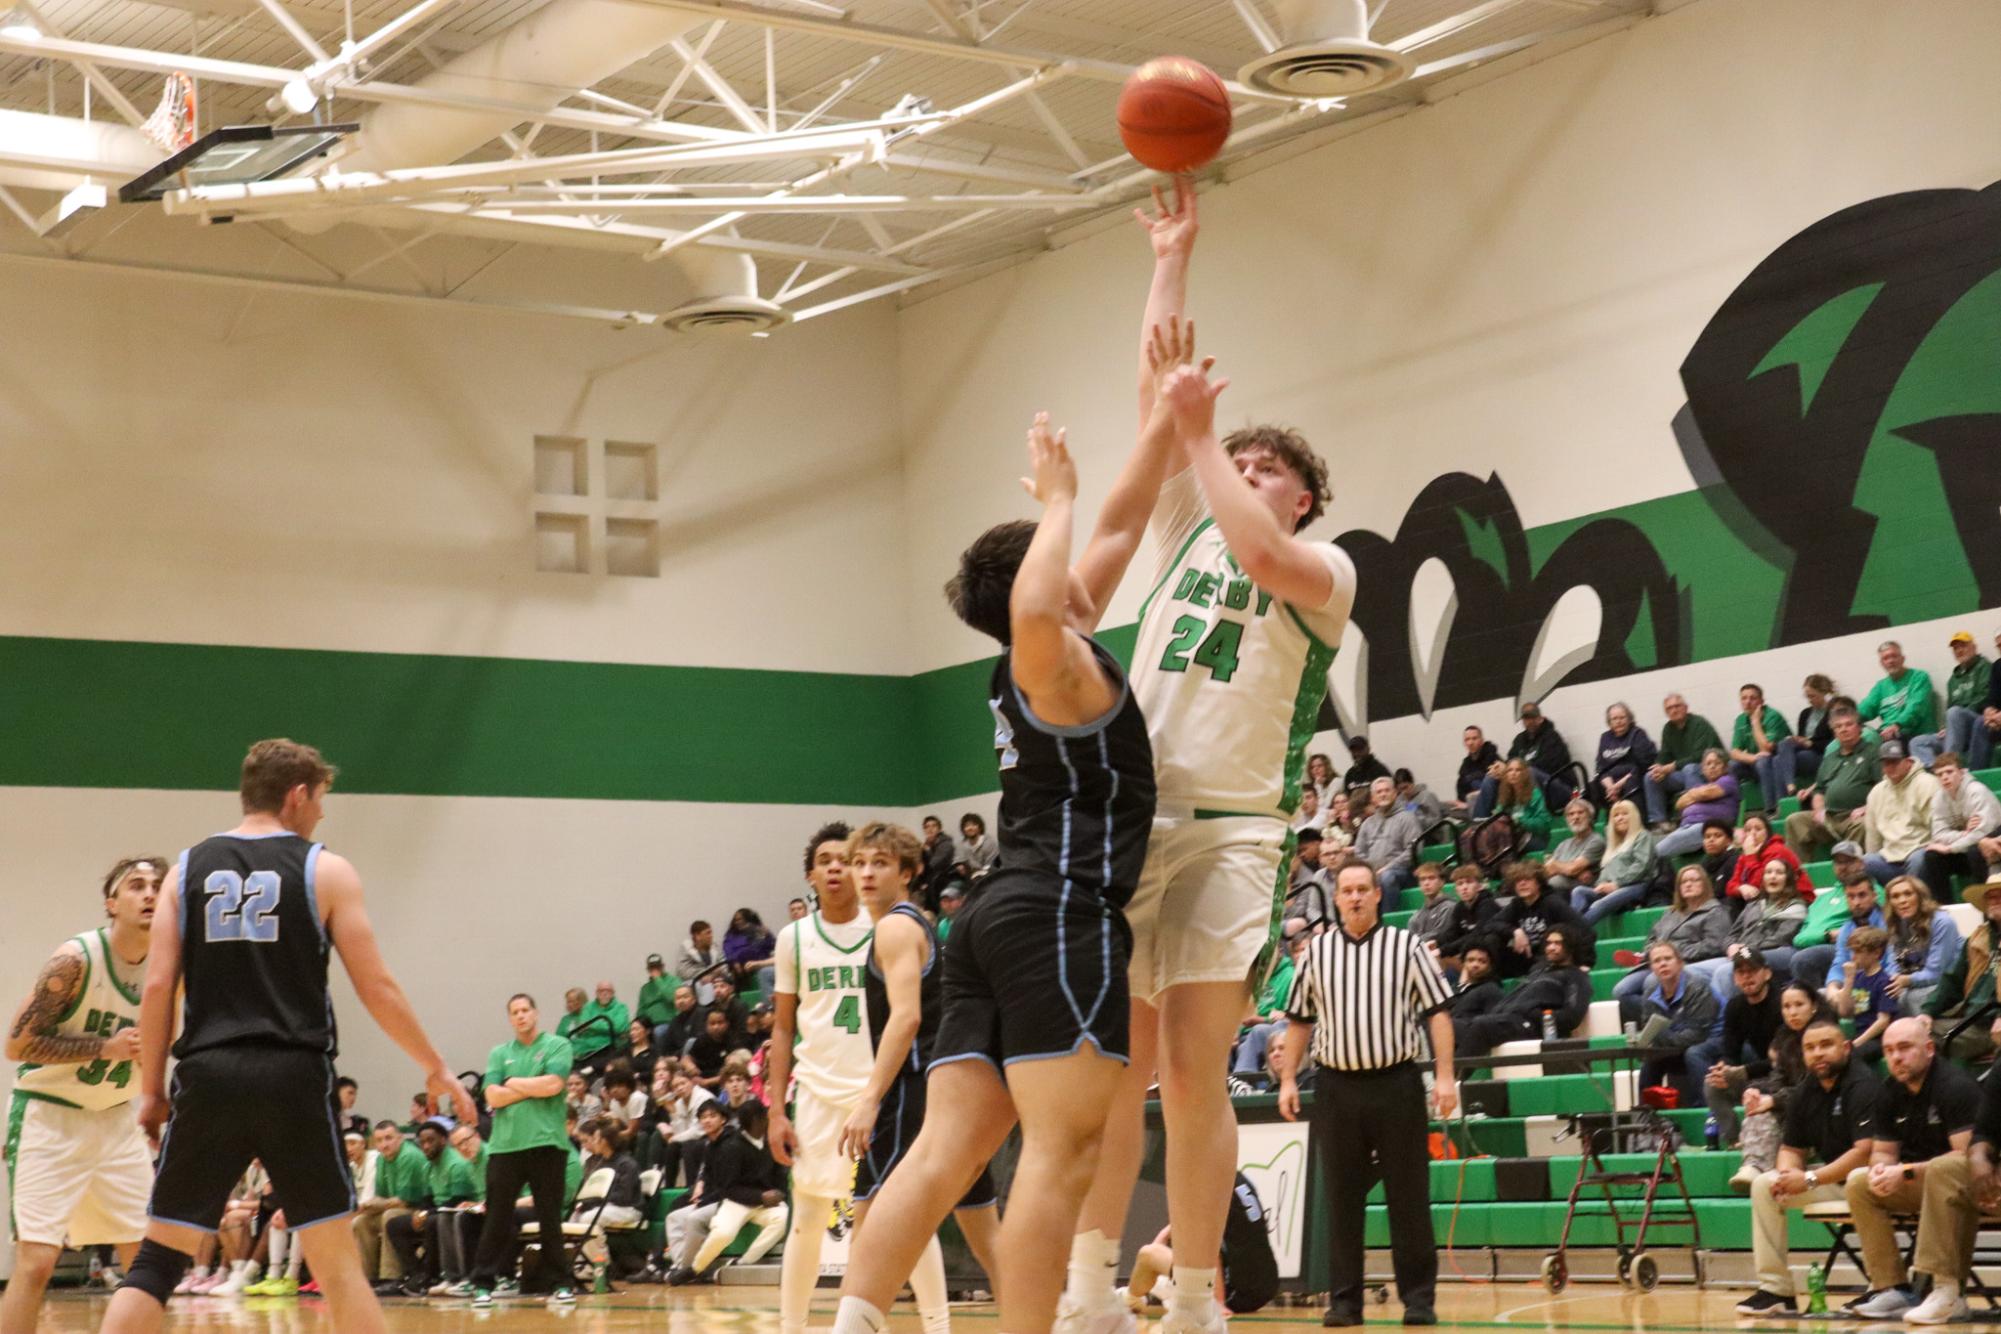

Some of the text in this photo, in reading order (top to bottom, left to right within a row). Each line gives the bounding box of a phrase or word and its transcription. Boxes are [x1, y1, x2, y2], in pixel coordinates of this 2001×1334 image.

[1158, 613, 1244, 683] 24
[204, 869, 281, 943] 22
[833, 995, 861, 1034] 4
[76, 1057, 132, 1090] 34
